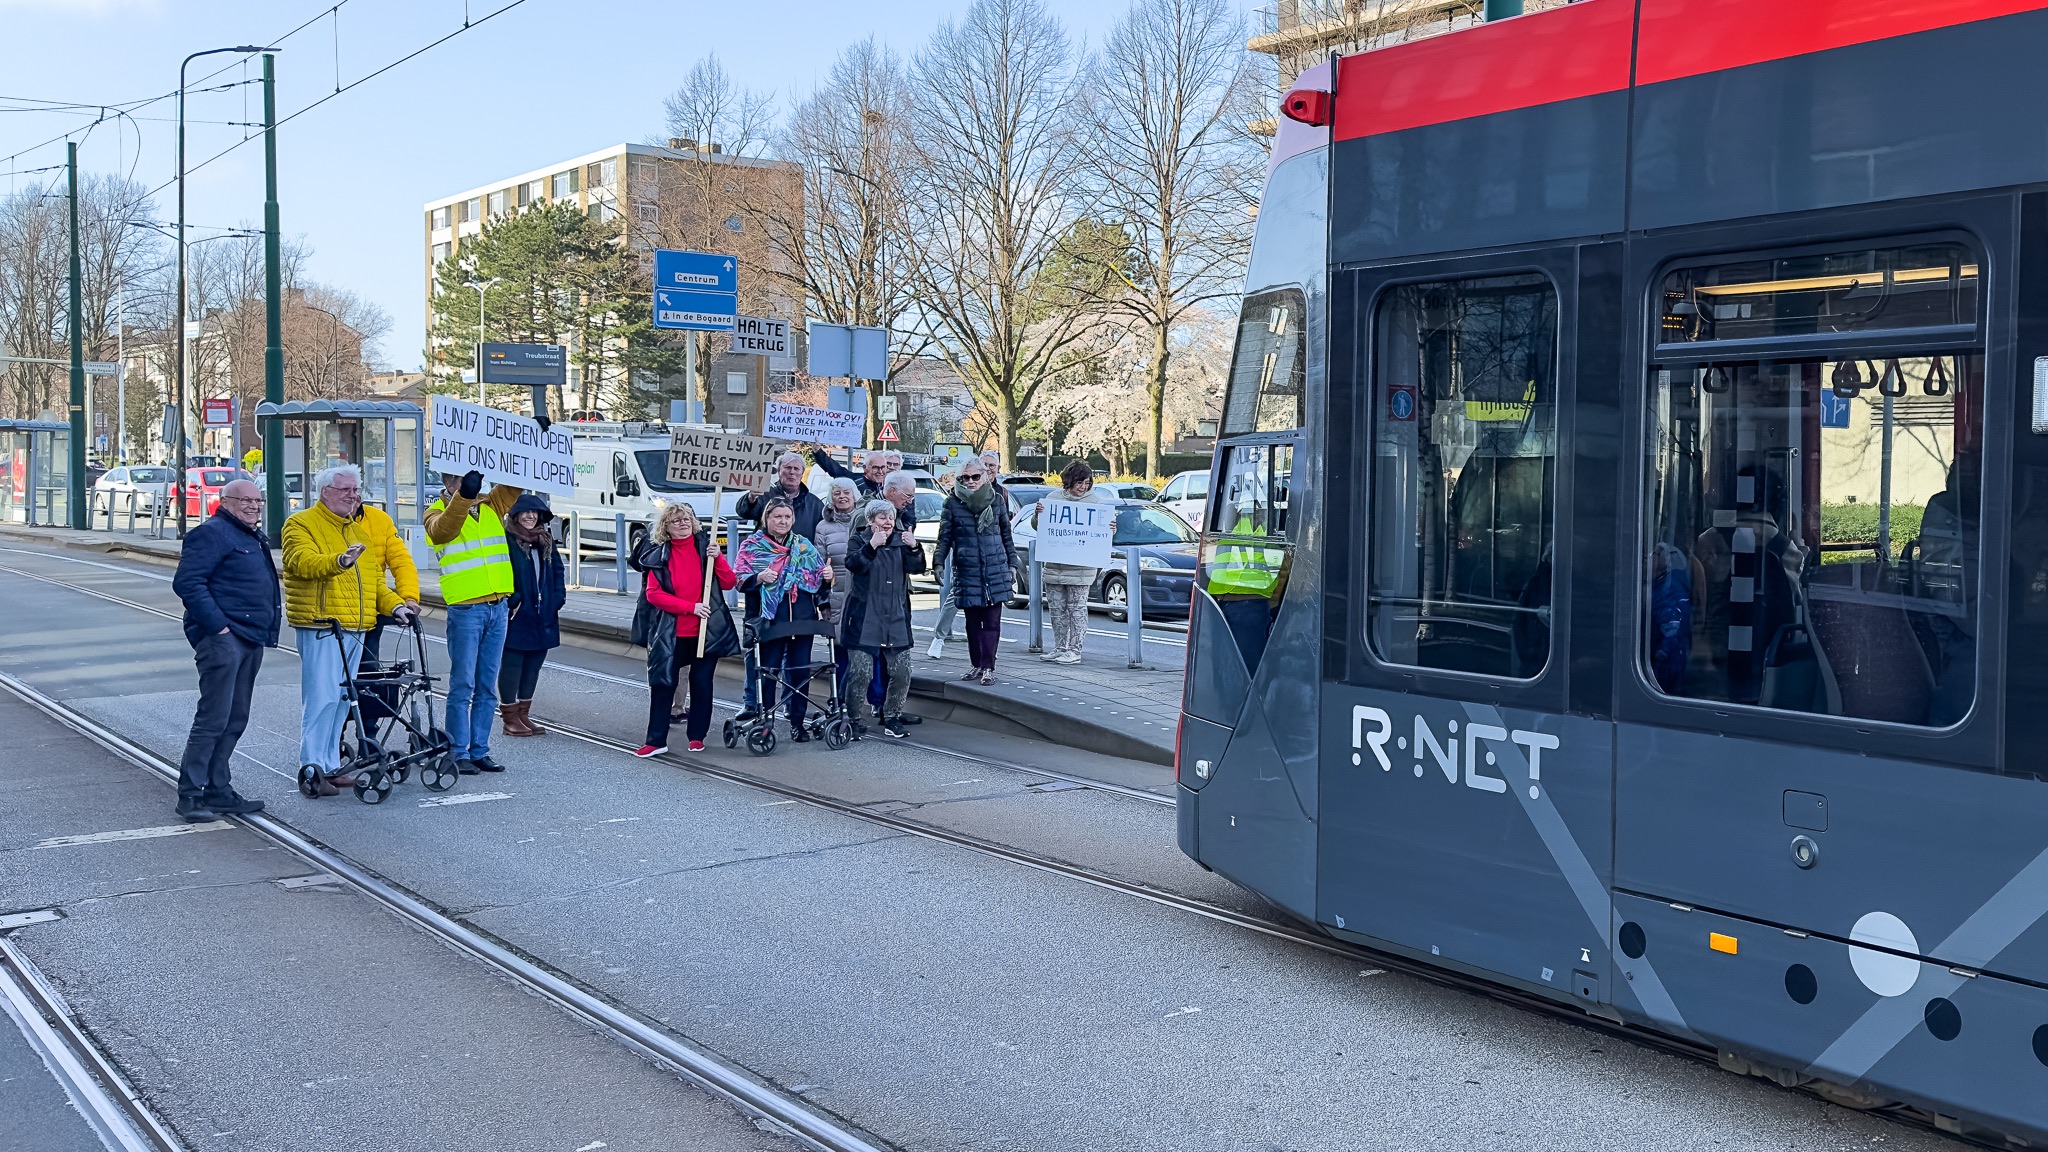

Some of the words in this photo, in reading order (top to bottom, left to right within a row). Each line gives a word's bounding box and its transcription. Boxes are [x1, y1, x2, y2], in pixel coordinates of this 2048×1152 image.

[677, 274, 716, 284] Centrum
[684, 312, 693, 320] de
[697, 314, 731, 323] Bogaard
[738, 319, 784, 337] HALTE
[738, 337, 784, 351] TERUG
[769, 415, 791, 424] MAAR
[795, 417, 815, 425] ONZE
[818, 419, 846, 428] HALTE
[486, 415, 538, 448] DEUREN
[540, 430, 573, 456] OPEN
[674, 433, 721, 450] HALTE
[759, 443, 774, 455] 17
[431, 436, 464, 463] LAAT
[468, 445, 496, 470] ONS
[500, 451, 529, 476] NIET
[533, 458, 574, 487] LOPEN
[671, 450, 771, 472] TREUBSTRAAT
[671, 467, 720, 482] TERUG
